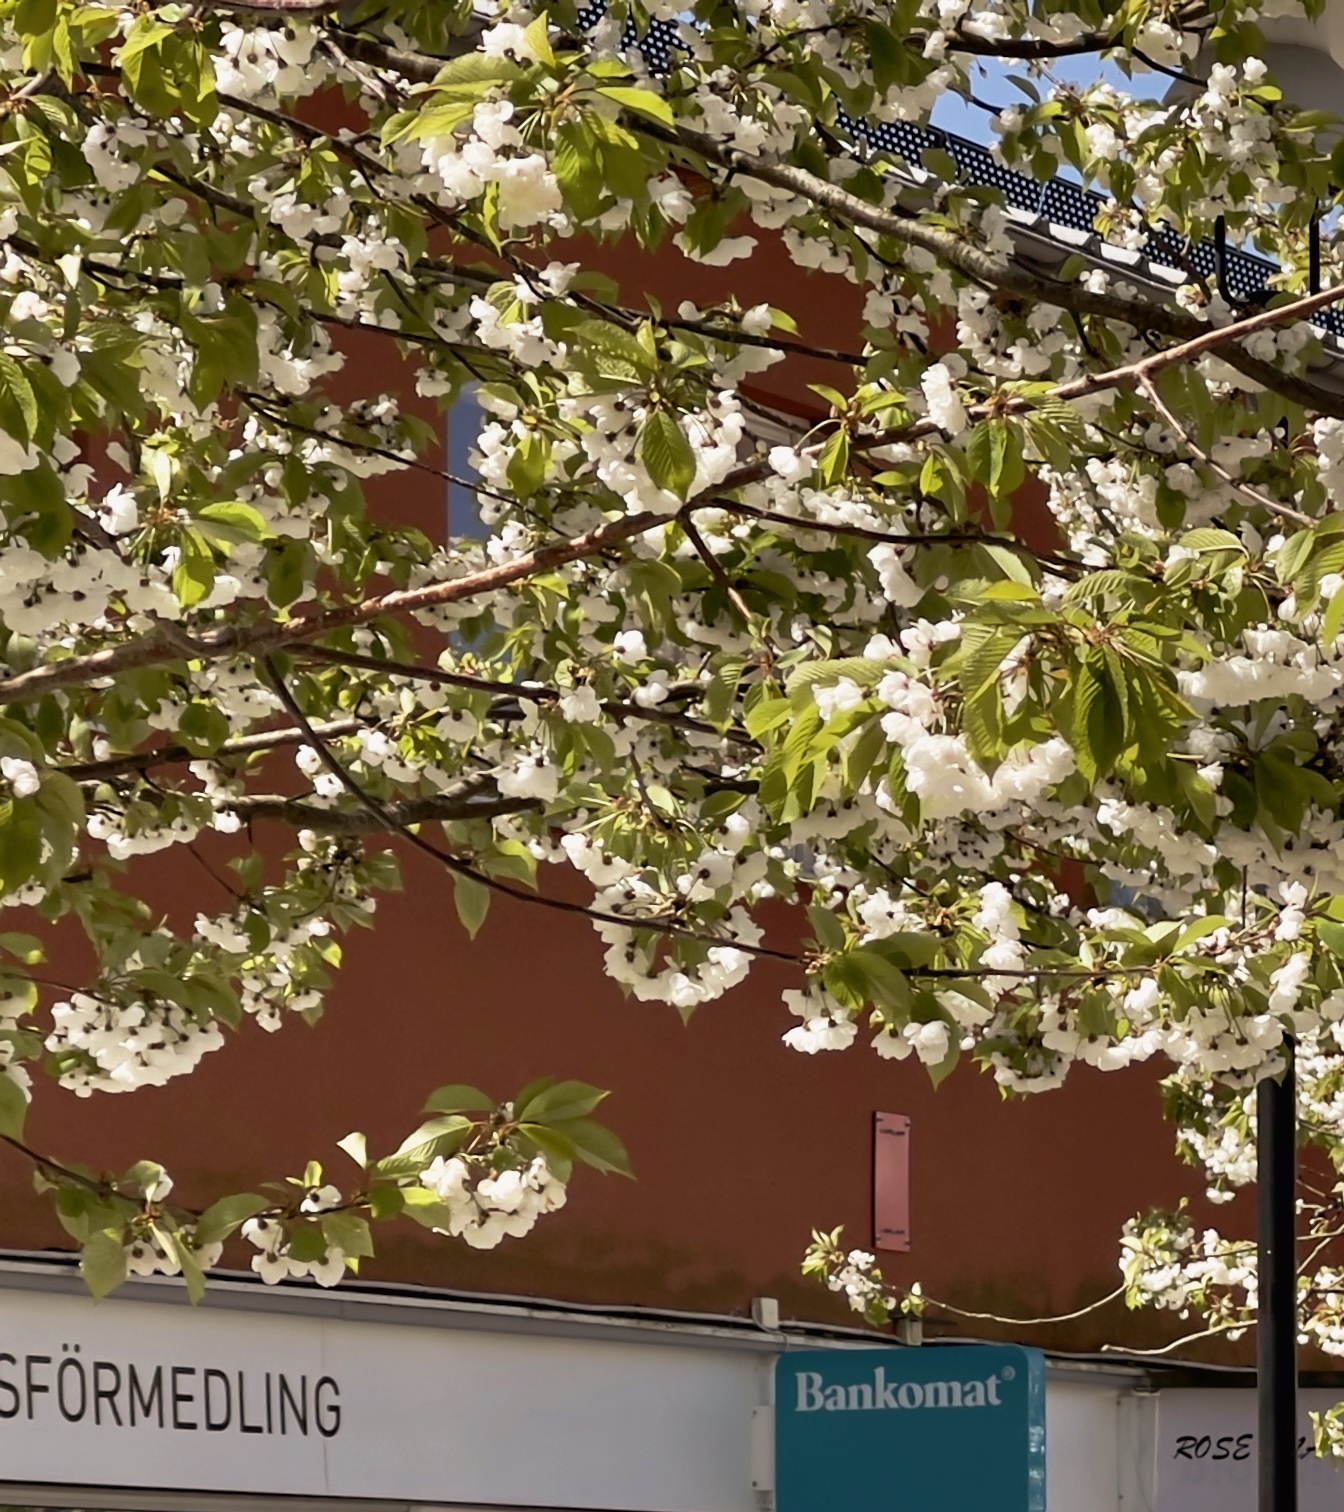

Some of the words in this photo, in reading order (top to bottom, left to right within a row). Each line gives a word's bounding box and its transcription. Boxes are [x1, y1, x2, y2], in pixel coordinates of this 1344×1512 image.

[0, 1343, 341, 1438] SFÖRMEDLING
[795, 1366, 1002, 1412] Bankomat
[1173, 1434, 1253, 1460] ROSE
